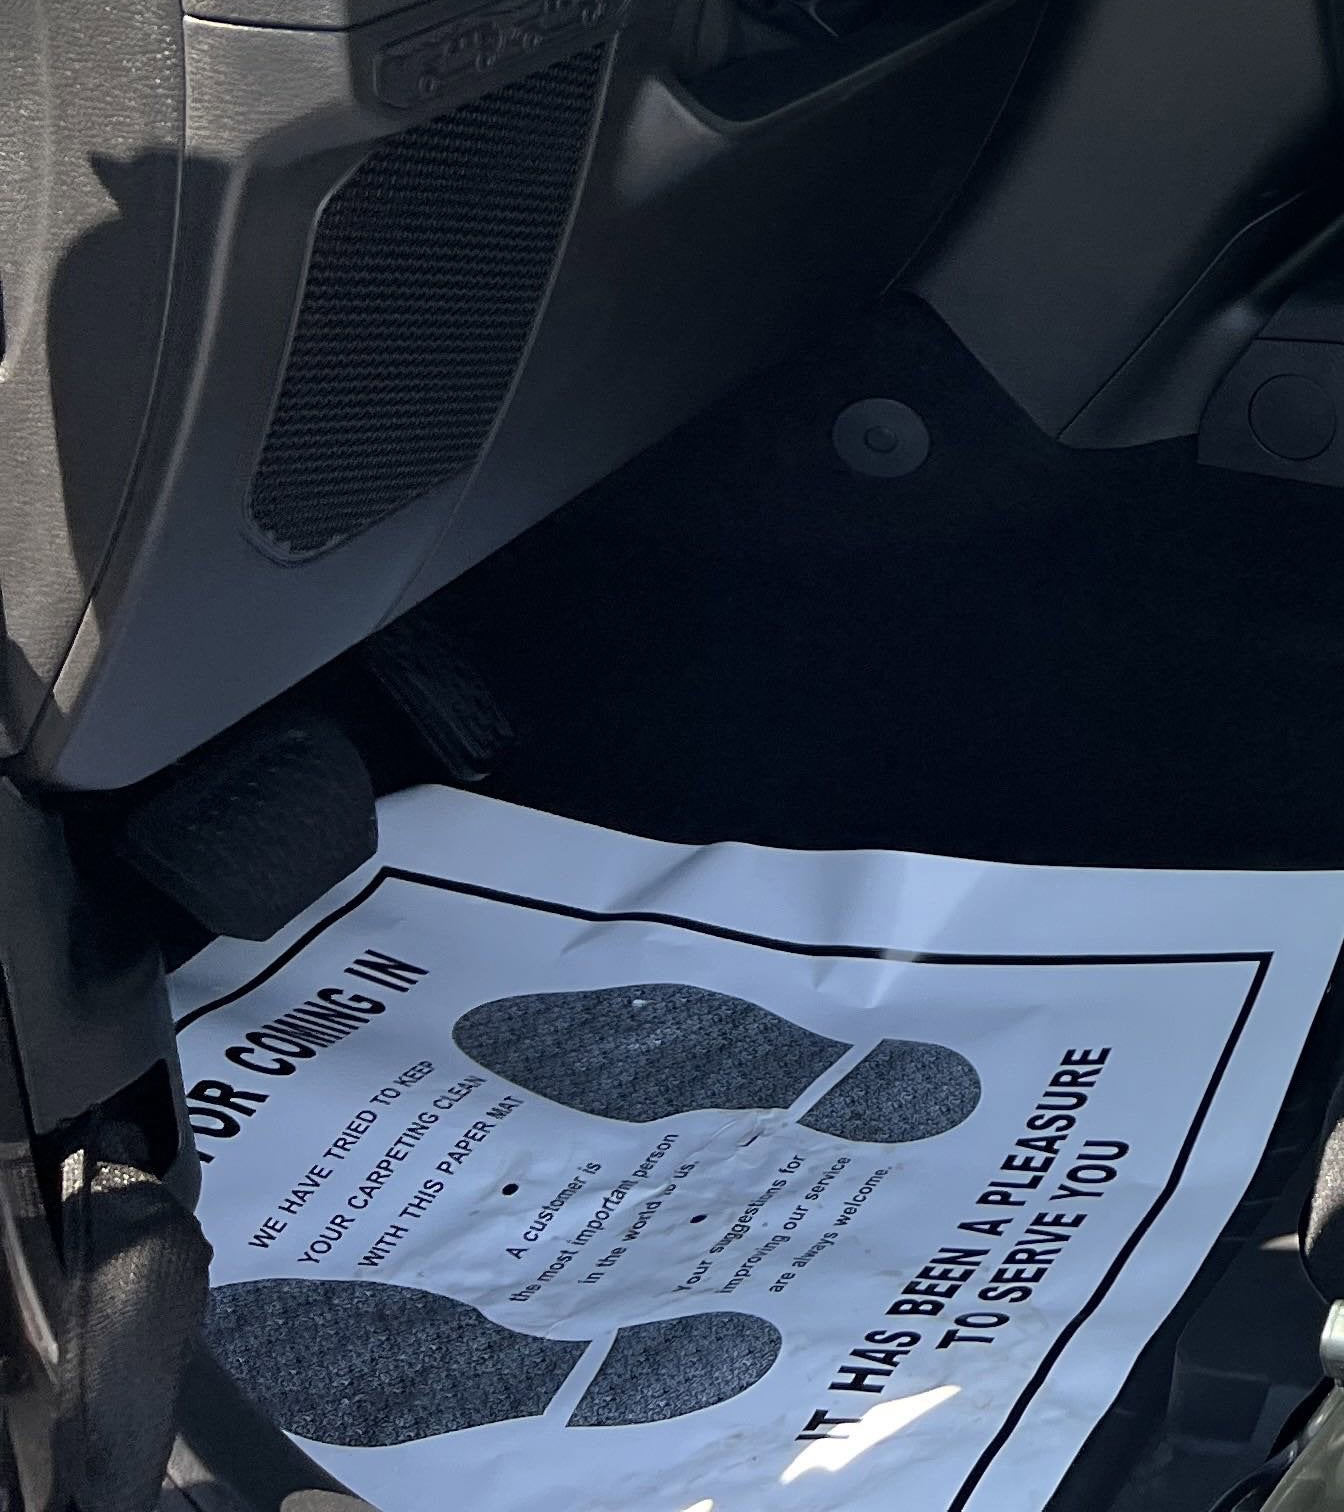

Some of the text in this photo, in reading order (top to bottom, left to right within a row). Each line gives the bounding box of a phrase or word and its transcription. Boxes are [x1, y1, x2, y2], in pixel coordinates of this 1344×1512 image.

[186, 948, 430, 1165] OR COMING IN
[248, 1060, 436, 1249] WE HAVE TRIED TO KEEP
[297, 1075, 488, 1265] YOUR CARPETING CLEAN
[357, 1095, 526, 1267] WITH THIS PAPER MAT
[505, 1161, 602, 1260] A customer is
[509, 1133, 680, 1303] the most important person
[577, 1271, 606, 1285] in
[595, 1246, 627, 1270] the
[673, 1160, 701, 1180] us.
[672, 1153, 807, 1293] Your suggestions for
[715, 1156, 852, 1294] improving our service
[768, 1165, 894, 1294] are always welcome.
[794, 1046, 1113, 1442] IT HAS BEEN A PLEASURE
[934, 1139, 1130, 1351] TO SERVE YOU
